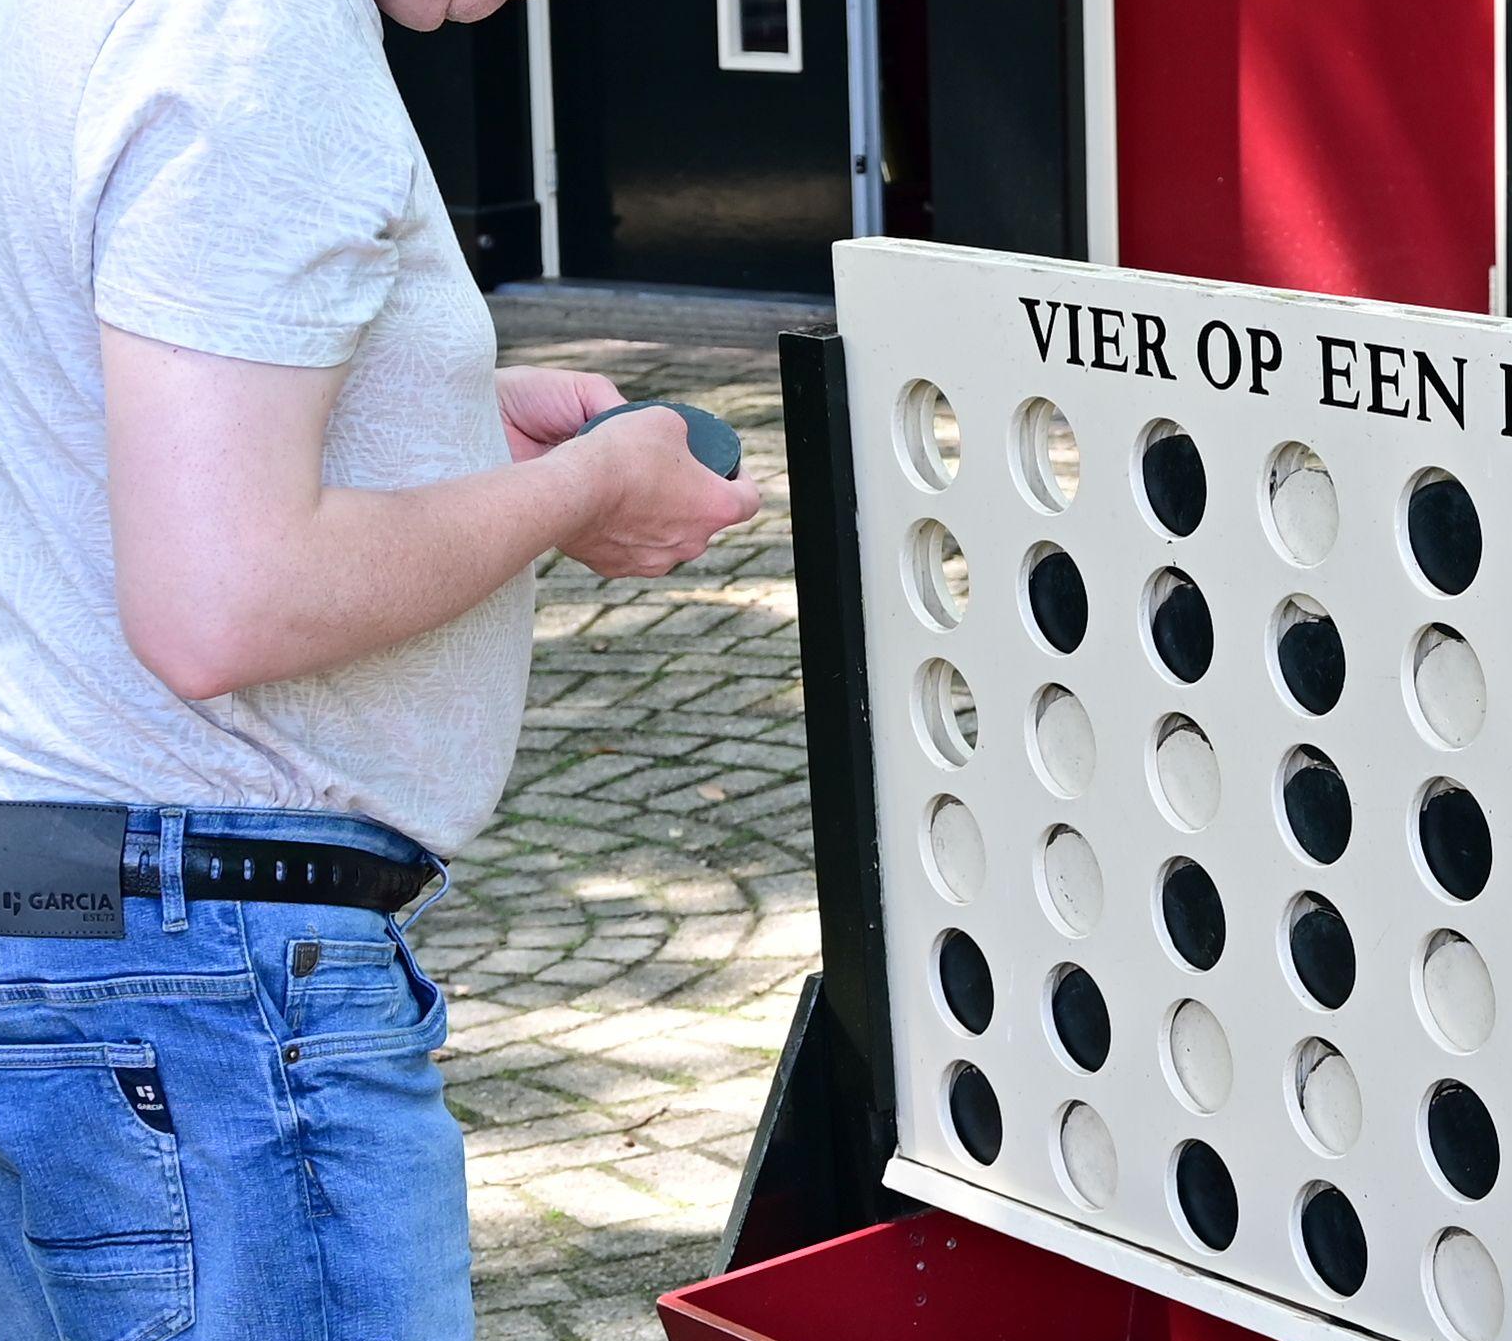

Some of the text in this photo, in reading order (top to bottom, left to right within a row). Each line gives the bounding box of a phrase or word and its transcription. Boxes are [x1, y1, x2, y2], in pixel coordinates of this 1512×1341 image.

[1018, 297, 1176, 380] VIER
[1197, 320, 1282, 395] OP
[1316, 335, 1468, 431] EEN
[28, 891, 115, 911] GARCIA
[83, 912, 115, 922] EST.72
